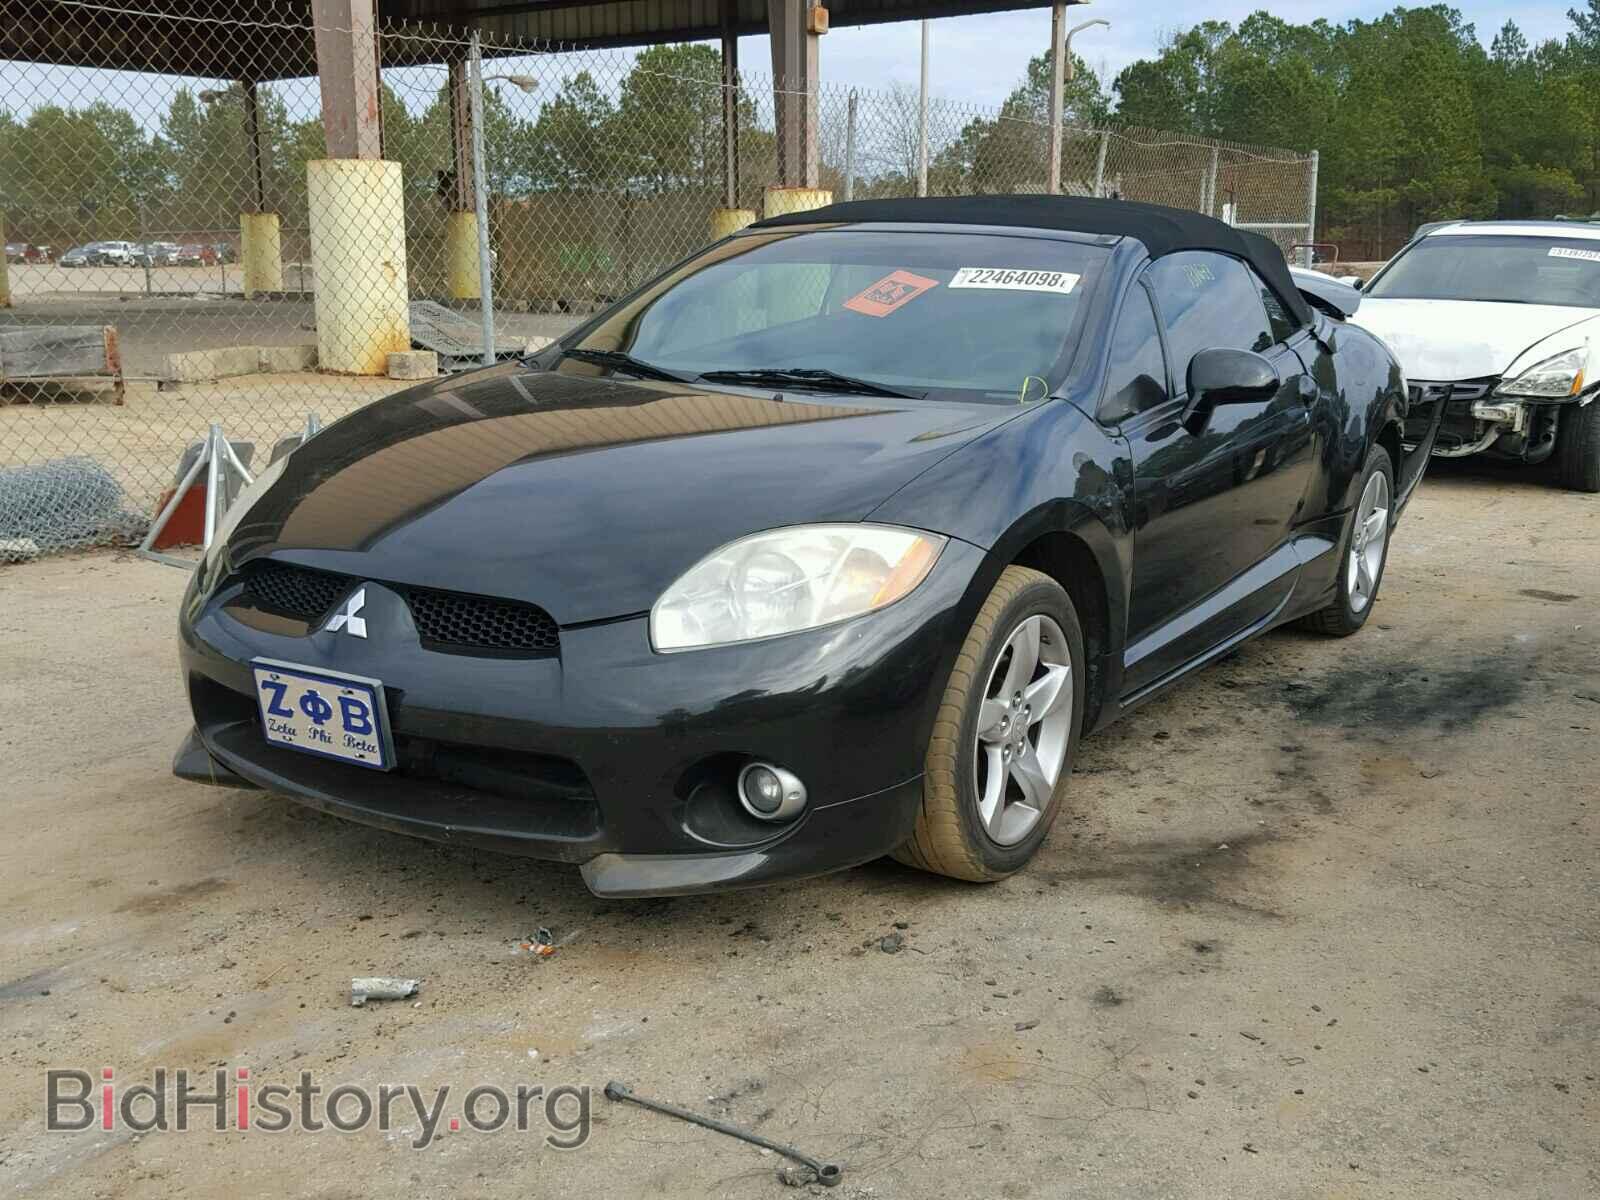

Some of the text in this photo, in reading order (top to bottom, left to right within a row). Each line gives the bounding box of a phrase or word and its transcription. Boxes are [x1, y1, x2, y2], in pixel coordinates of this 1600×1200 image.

[968, 269, 1063, 287] 22464098
[267, 718, 378, 754] Zeta Phi Beta
